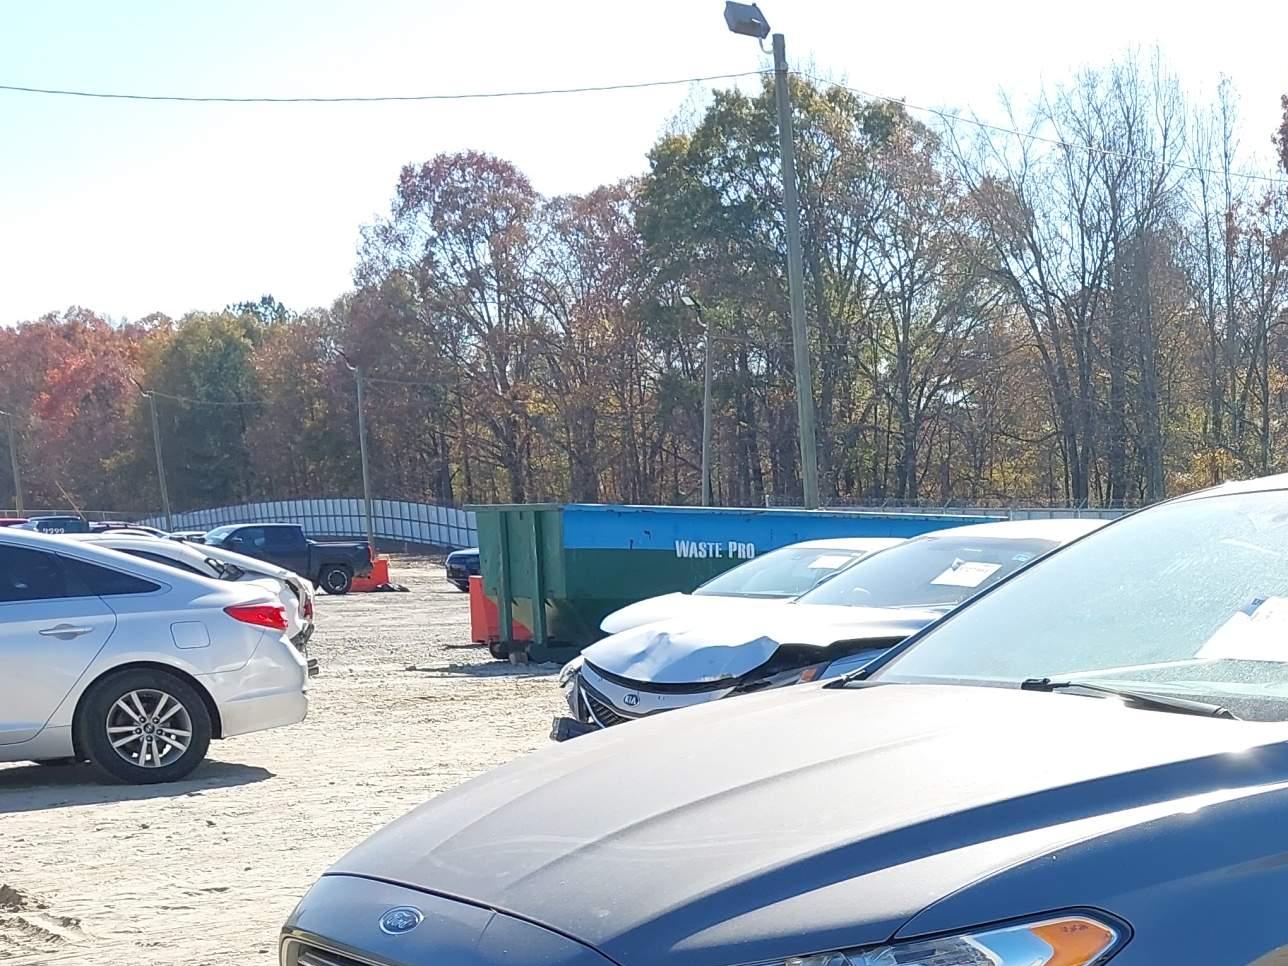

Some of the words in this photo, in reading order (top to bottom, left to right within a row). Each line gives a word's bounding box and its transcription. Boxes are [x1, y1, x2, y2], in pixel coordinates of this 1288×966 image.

[675, 540, 723, 558] WASTE
[728, 541, 755, 559] PRO
[624, 694, 640, 706] KIA
